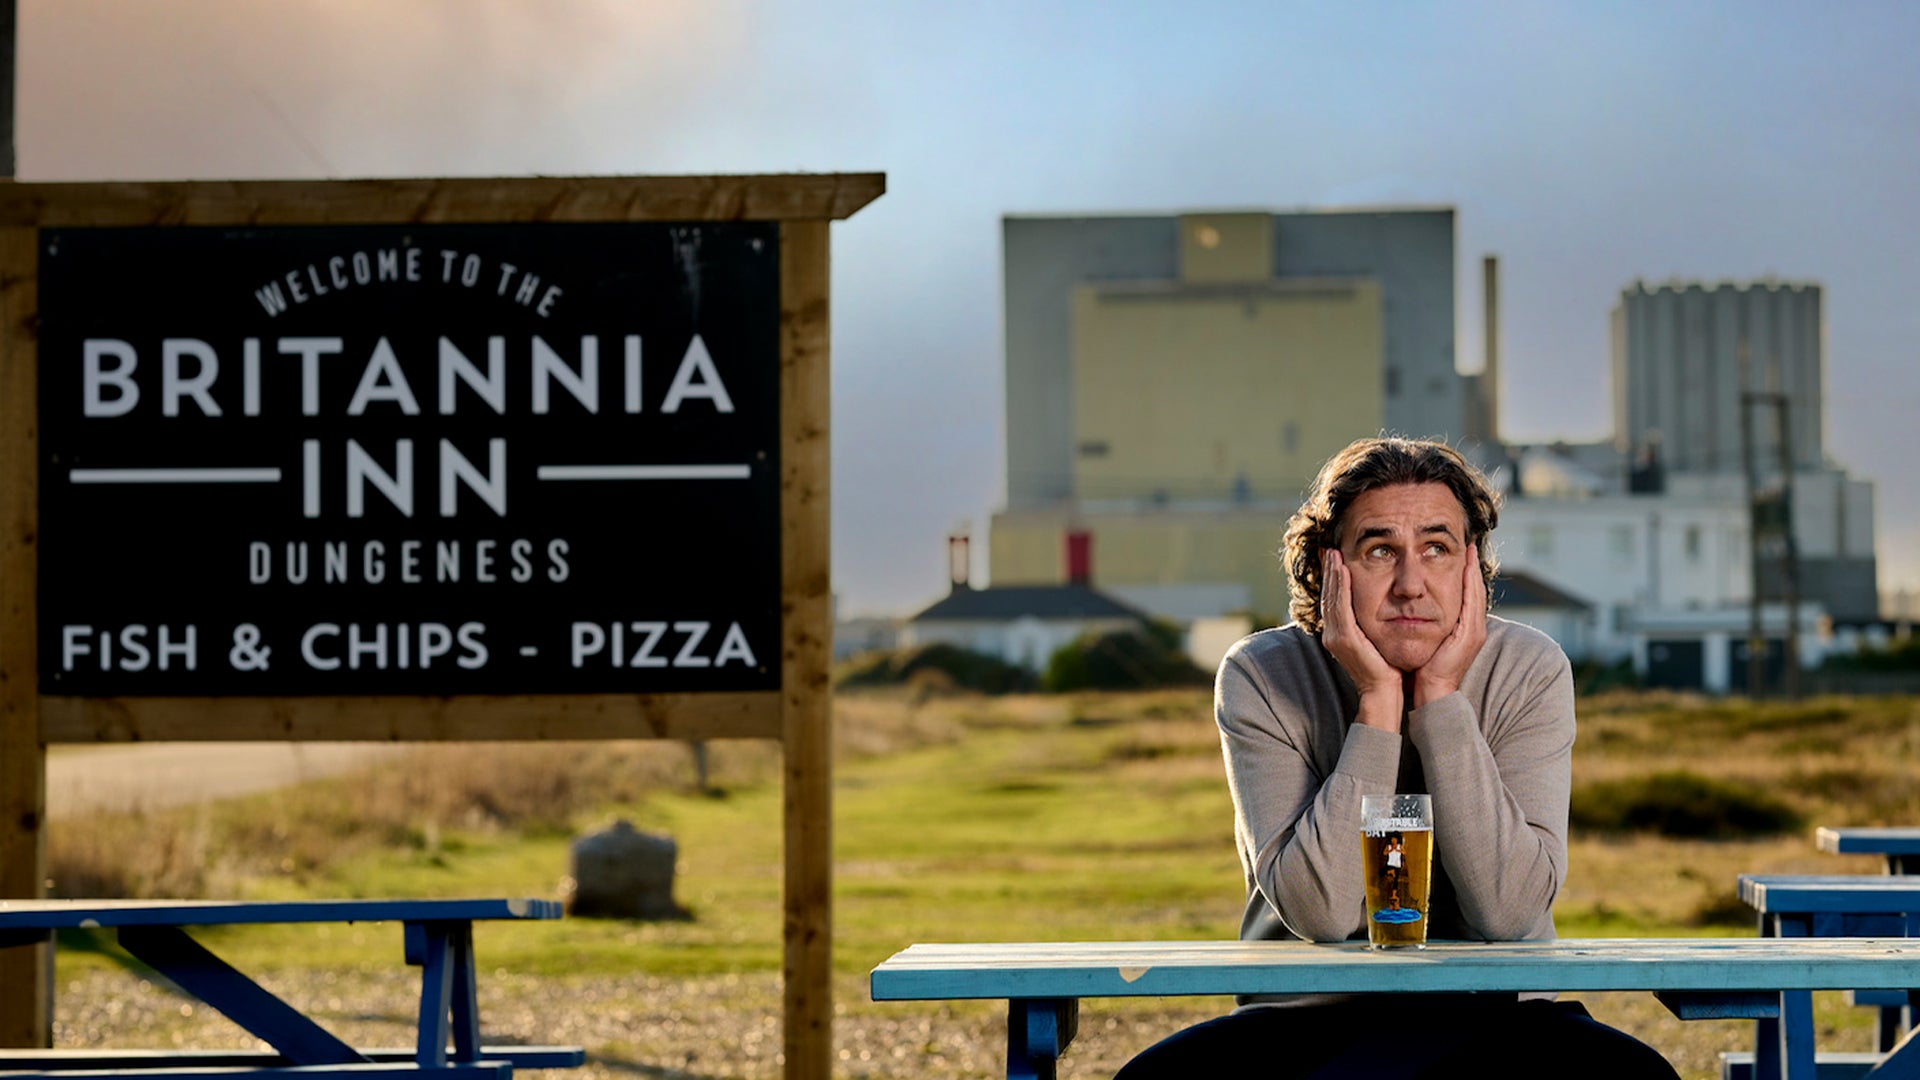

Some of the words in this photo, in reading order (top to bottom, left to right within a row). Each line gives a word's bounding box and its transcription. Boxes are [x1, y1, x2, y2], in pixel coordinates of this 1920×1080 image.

[255, 248, 423, 318] WELCOME
[440, 250, 482, 287] TO
[497, 263, 564, 318] THE
[82, 333, 735, 418] BRITANNIA
[302, 437, 507, 519] INN
[249, 539, 570, 585] DUNGENESS
[229, 622, 272, 671] &
[300, 622, 489, 670] CHIPS
[571, 620, 757, 668] PIZZA
